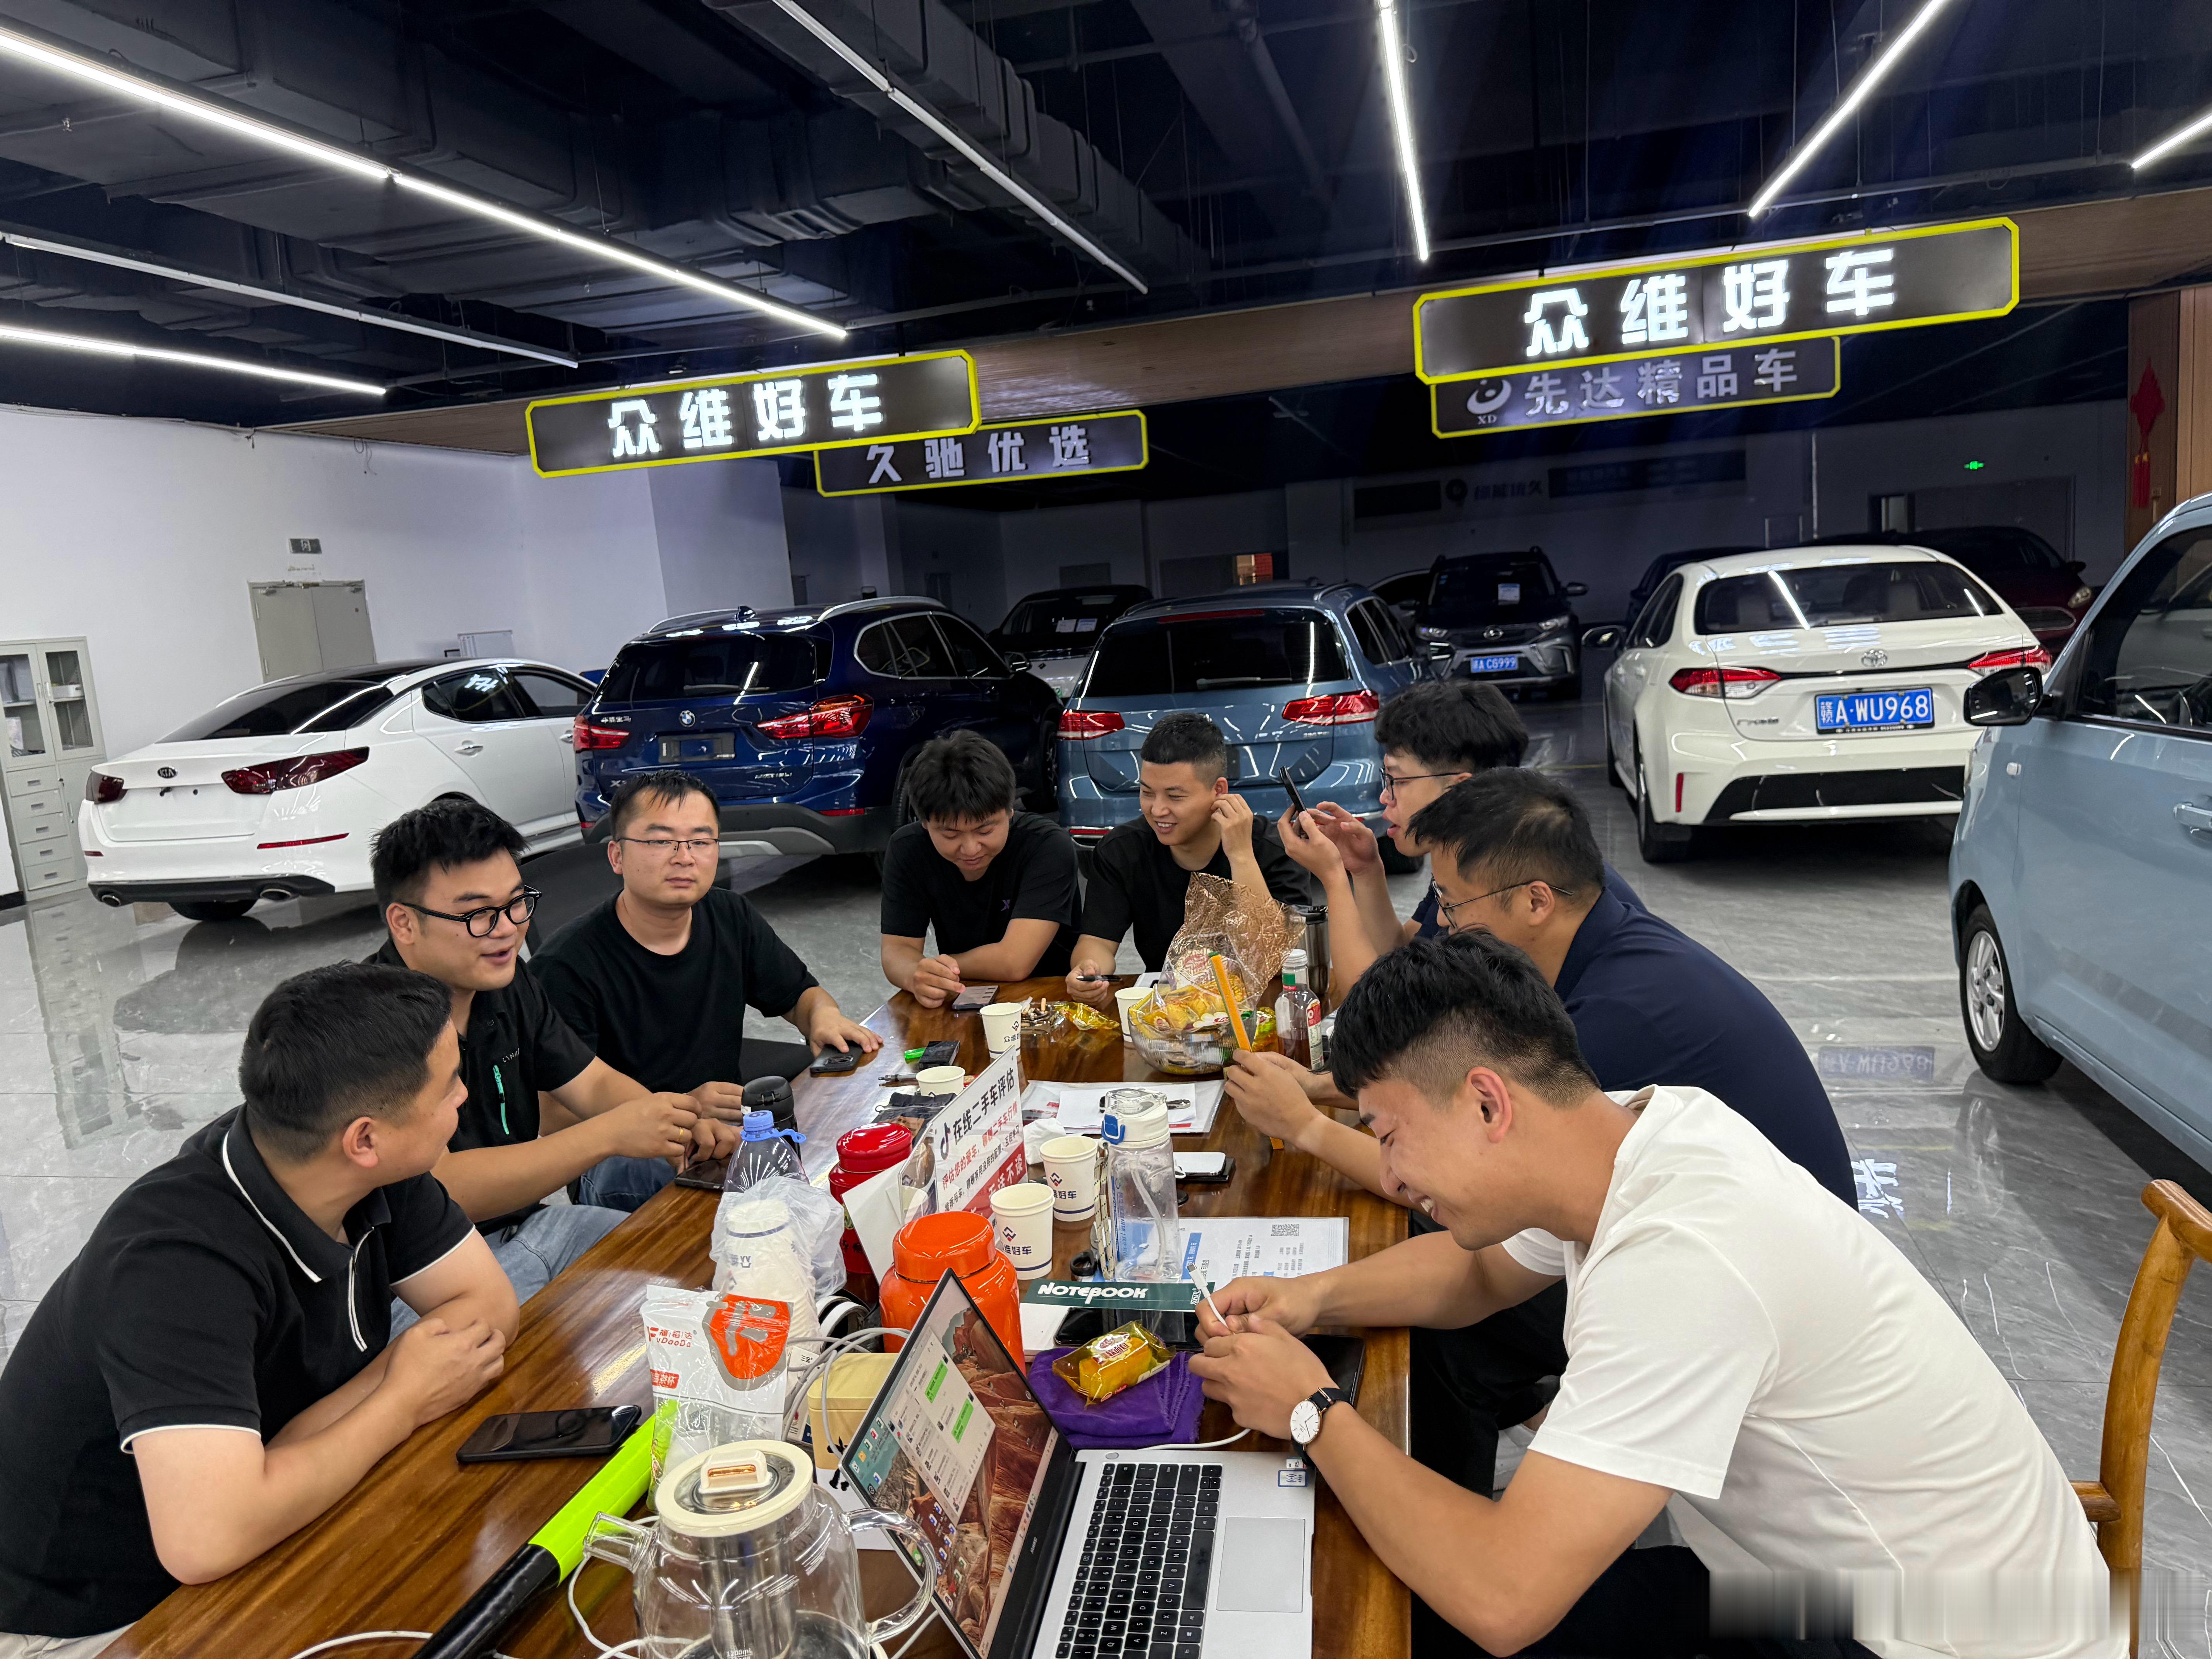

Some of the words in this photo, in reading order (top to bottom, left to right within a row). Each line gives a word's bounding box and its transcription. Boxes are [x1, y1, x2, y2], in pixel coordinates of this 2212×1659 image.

[1524, 248, 1893, 357] 众维好车
[1523, 348, 1797, 418] 先达精品车
[608, 374, 883, 457] 众维好车
[1478, 416, 1497, 424] XD
[867, 427, 1089, 484] 久驰优选
[160, 769, 174, 777] KIA
[953, 1068, 1014, 1145] 在线二手车评估
[1037, 1282, 1149, 1304] NOTEBOOK
